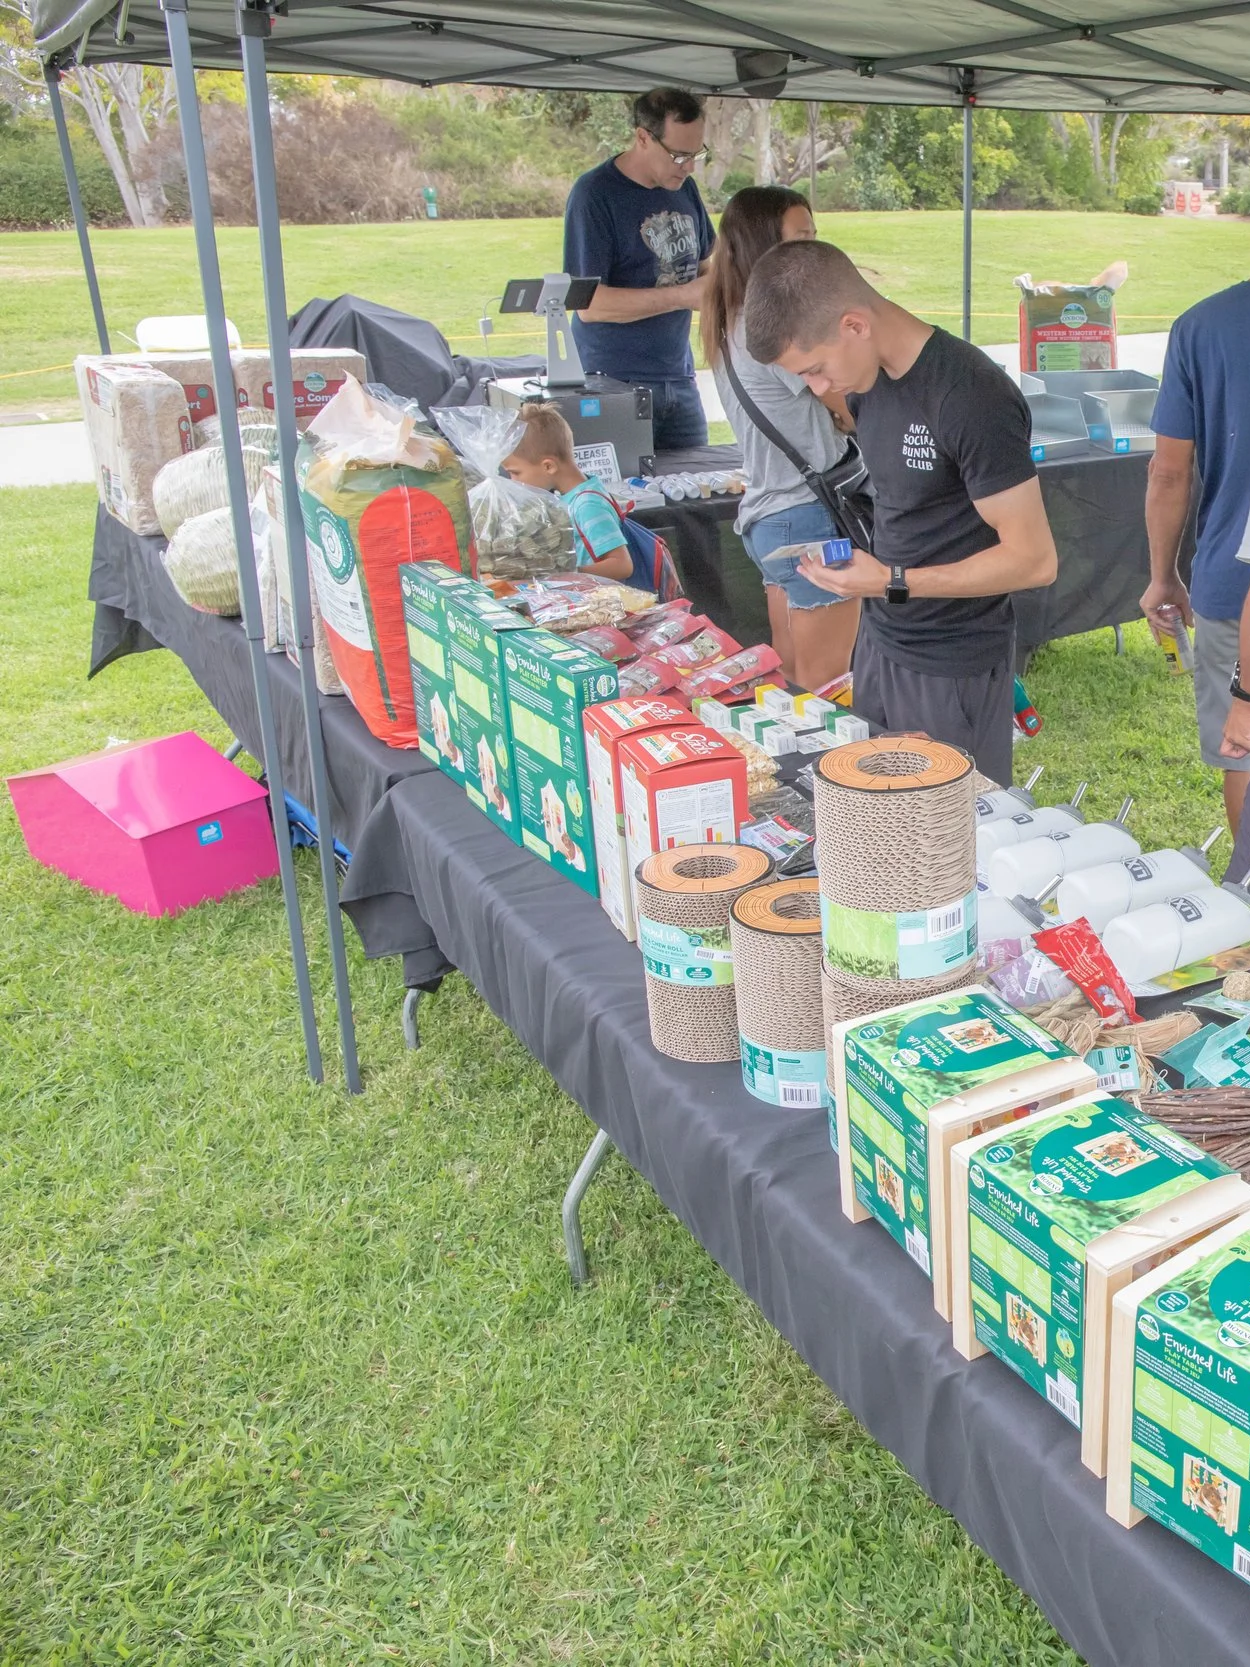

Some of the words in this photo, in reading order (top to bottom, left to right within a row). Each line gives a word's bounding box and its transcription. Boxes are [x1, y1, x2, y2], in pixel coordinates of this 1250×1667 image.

[903, 434, 936, 446] SOCIAL
[574, 447, 606, 459] PLEASE
[902, 446, 937, 459] BUNNY
[594, 458, 610, 466] FEED
[906, 459, 934, 471] CLUB
[905, 1033, 921, 1048] Life
[914, 1041, 947, 1067] Enriched
[851, 1052, 889, 1085] Enriched
[879, 1075, 900, 1095] Life
[1040, 1154, 1059, 1171] Life
[1057, 1155, 1079, 1173] TABLE
[1036, 1173, 1062, 1192] OXBOW
[1054, 1164, 1093, 1194] Enriched
[1076, 1169, 1094, 1183] PLAY
[980, 1179, 1027, 1216] Enriched
[1019, 1206, 1044, 1229] Life
[1221, 1297, 1244, 1317] Life
[1157, 1328, 1218, 1372] Enriched
[1211, 1360, 1242, 1387] Life
[1162, 1346, 1182, 1361] PLAY
[1180, 1357, 1204, 1374] TABLE
